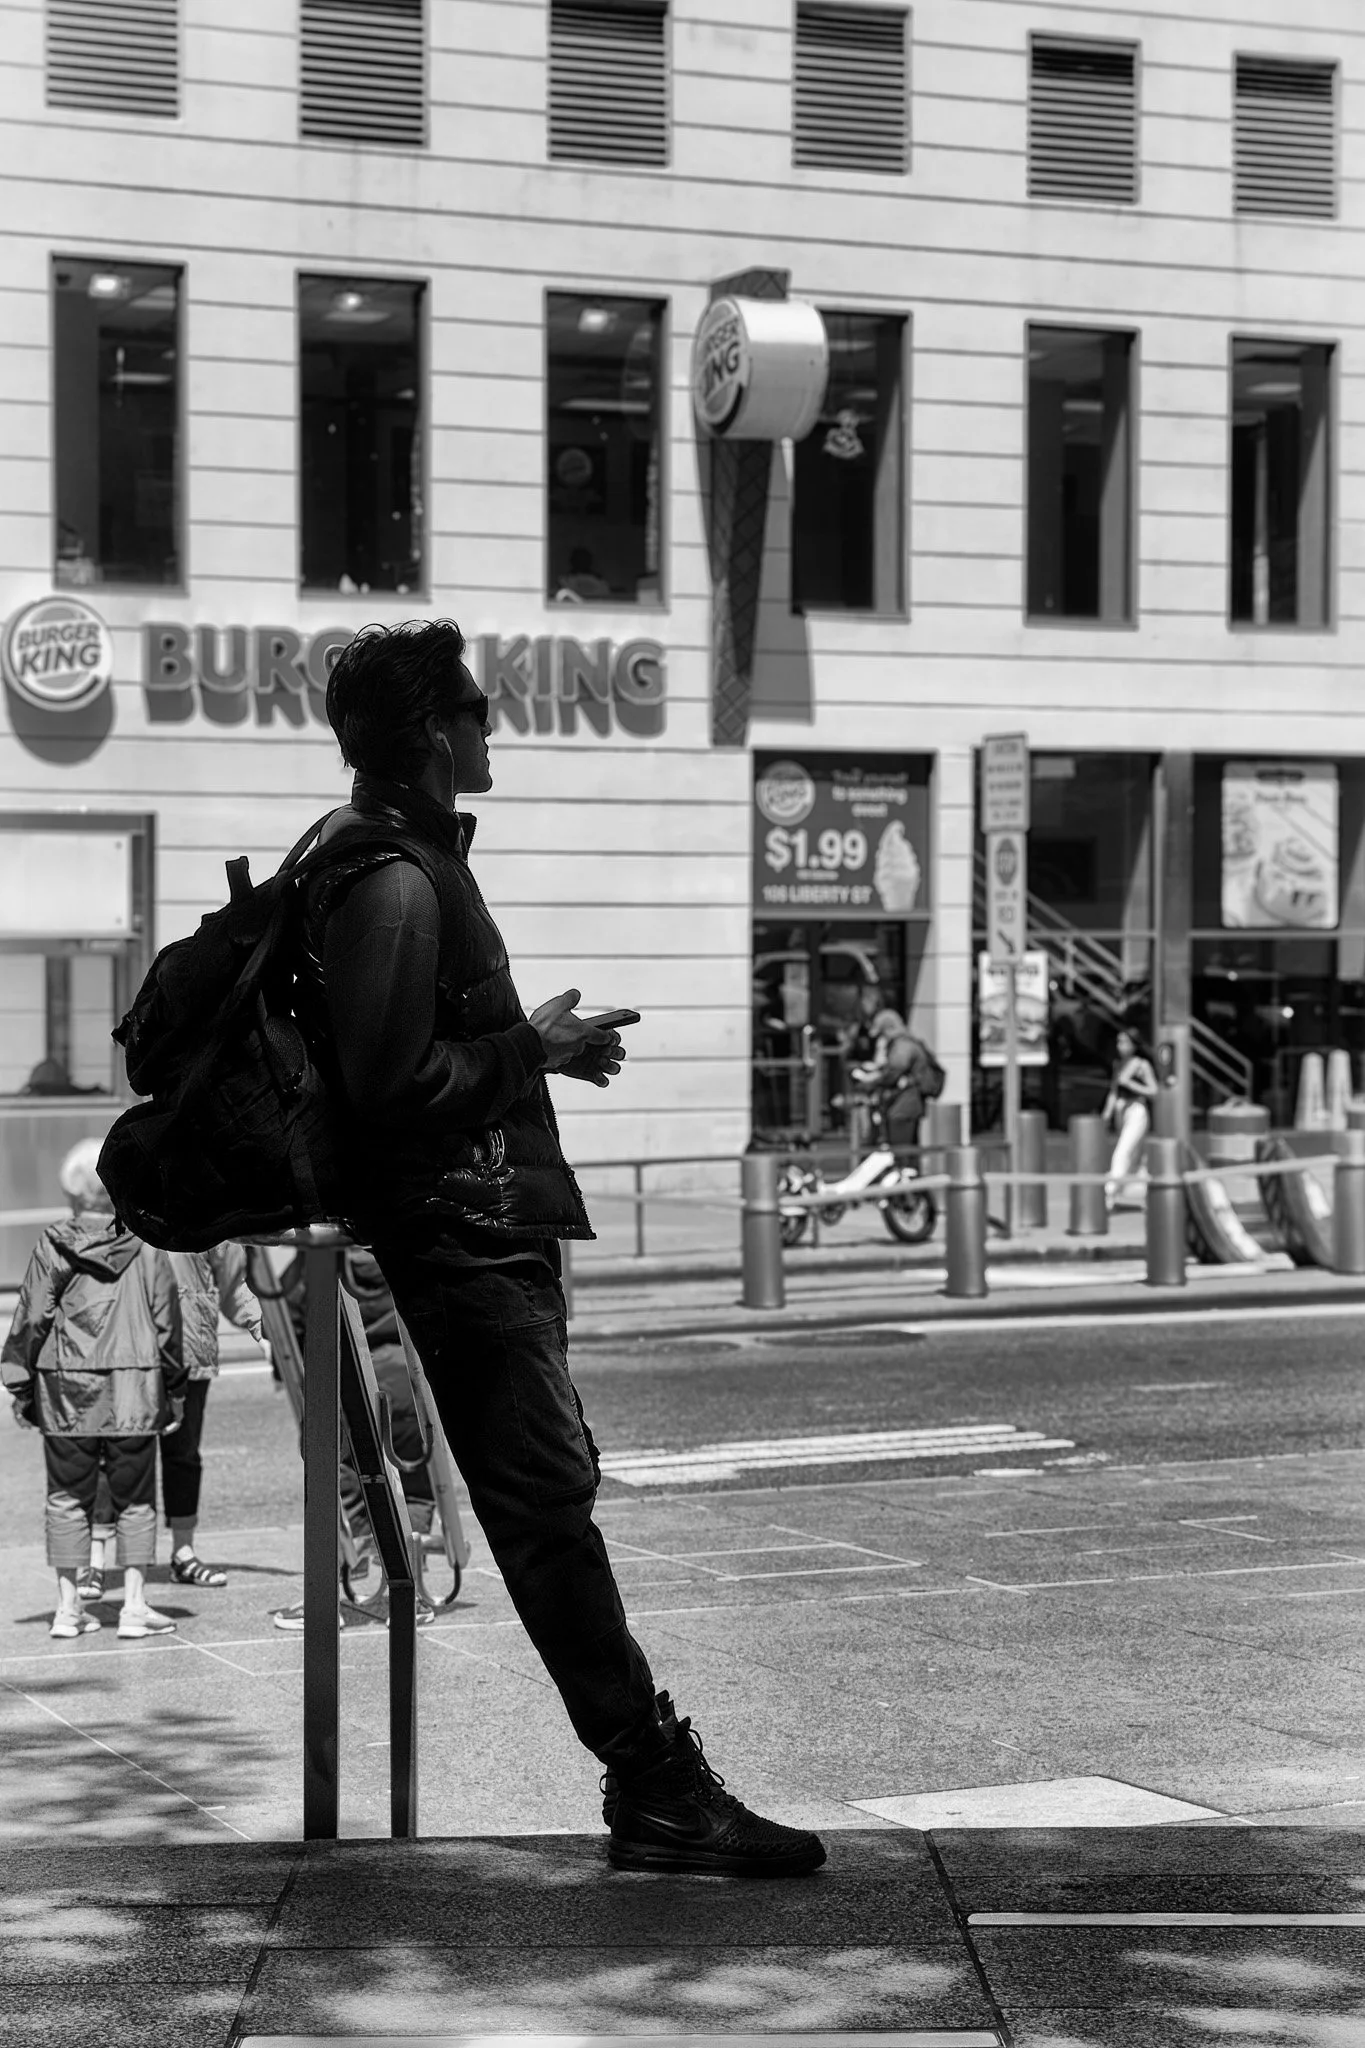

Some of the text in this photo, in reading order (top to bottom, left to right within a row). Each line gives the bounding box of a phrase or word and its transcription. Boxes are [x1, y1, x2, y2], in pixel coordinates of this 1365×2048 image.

[18, 621, 100, 650] BURGER
[20, 642, 102, 676] KING
[477, 633, 667, 705] KING
[765, 826, 868, 872] $1.99
[789, 885, 850, 902] LIBERTY
